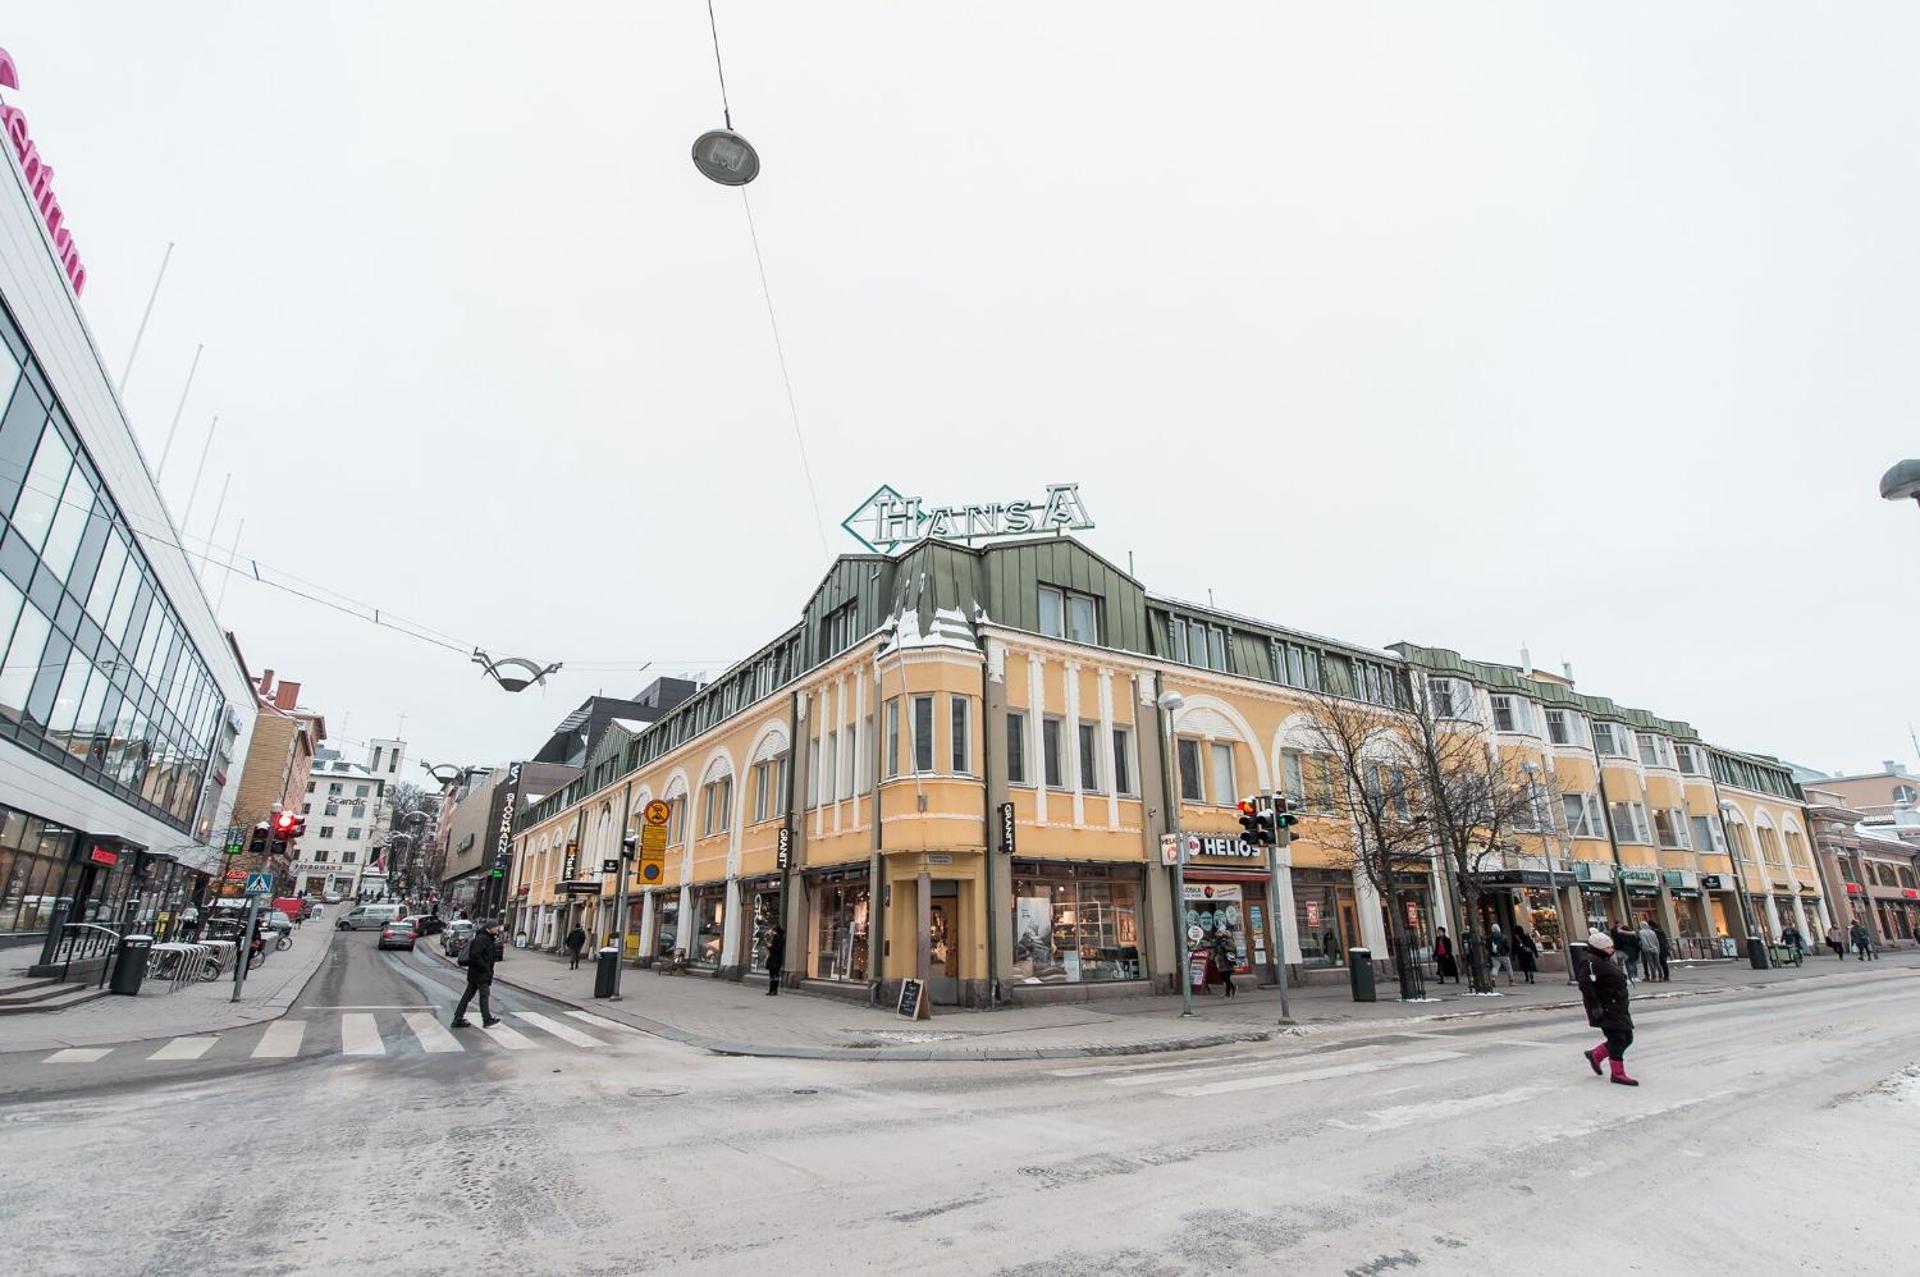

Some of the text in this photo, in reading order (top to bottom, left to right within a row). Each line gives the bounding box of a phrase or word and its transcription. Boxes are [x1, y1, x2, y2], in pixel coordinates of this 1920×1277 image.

[872, 483, 1095, 544] HANSA
[327, 796, 367, 806] Scandic
[498, 792, 515, 853] STOCKMANN
[778, 828, 789, 868] GRANIT
[1003, 804, 1013, 851] GRANIT
[1203, 837, 1261, 857] HELIOS
